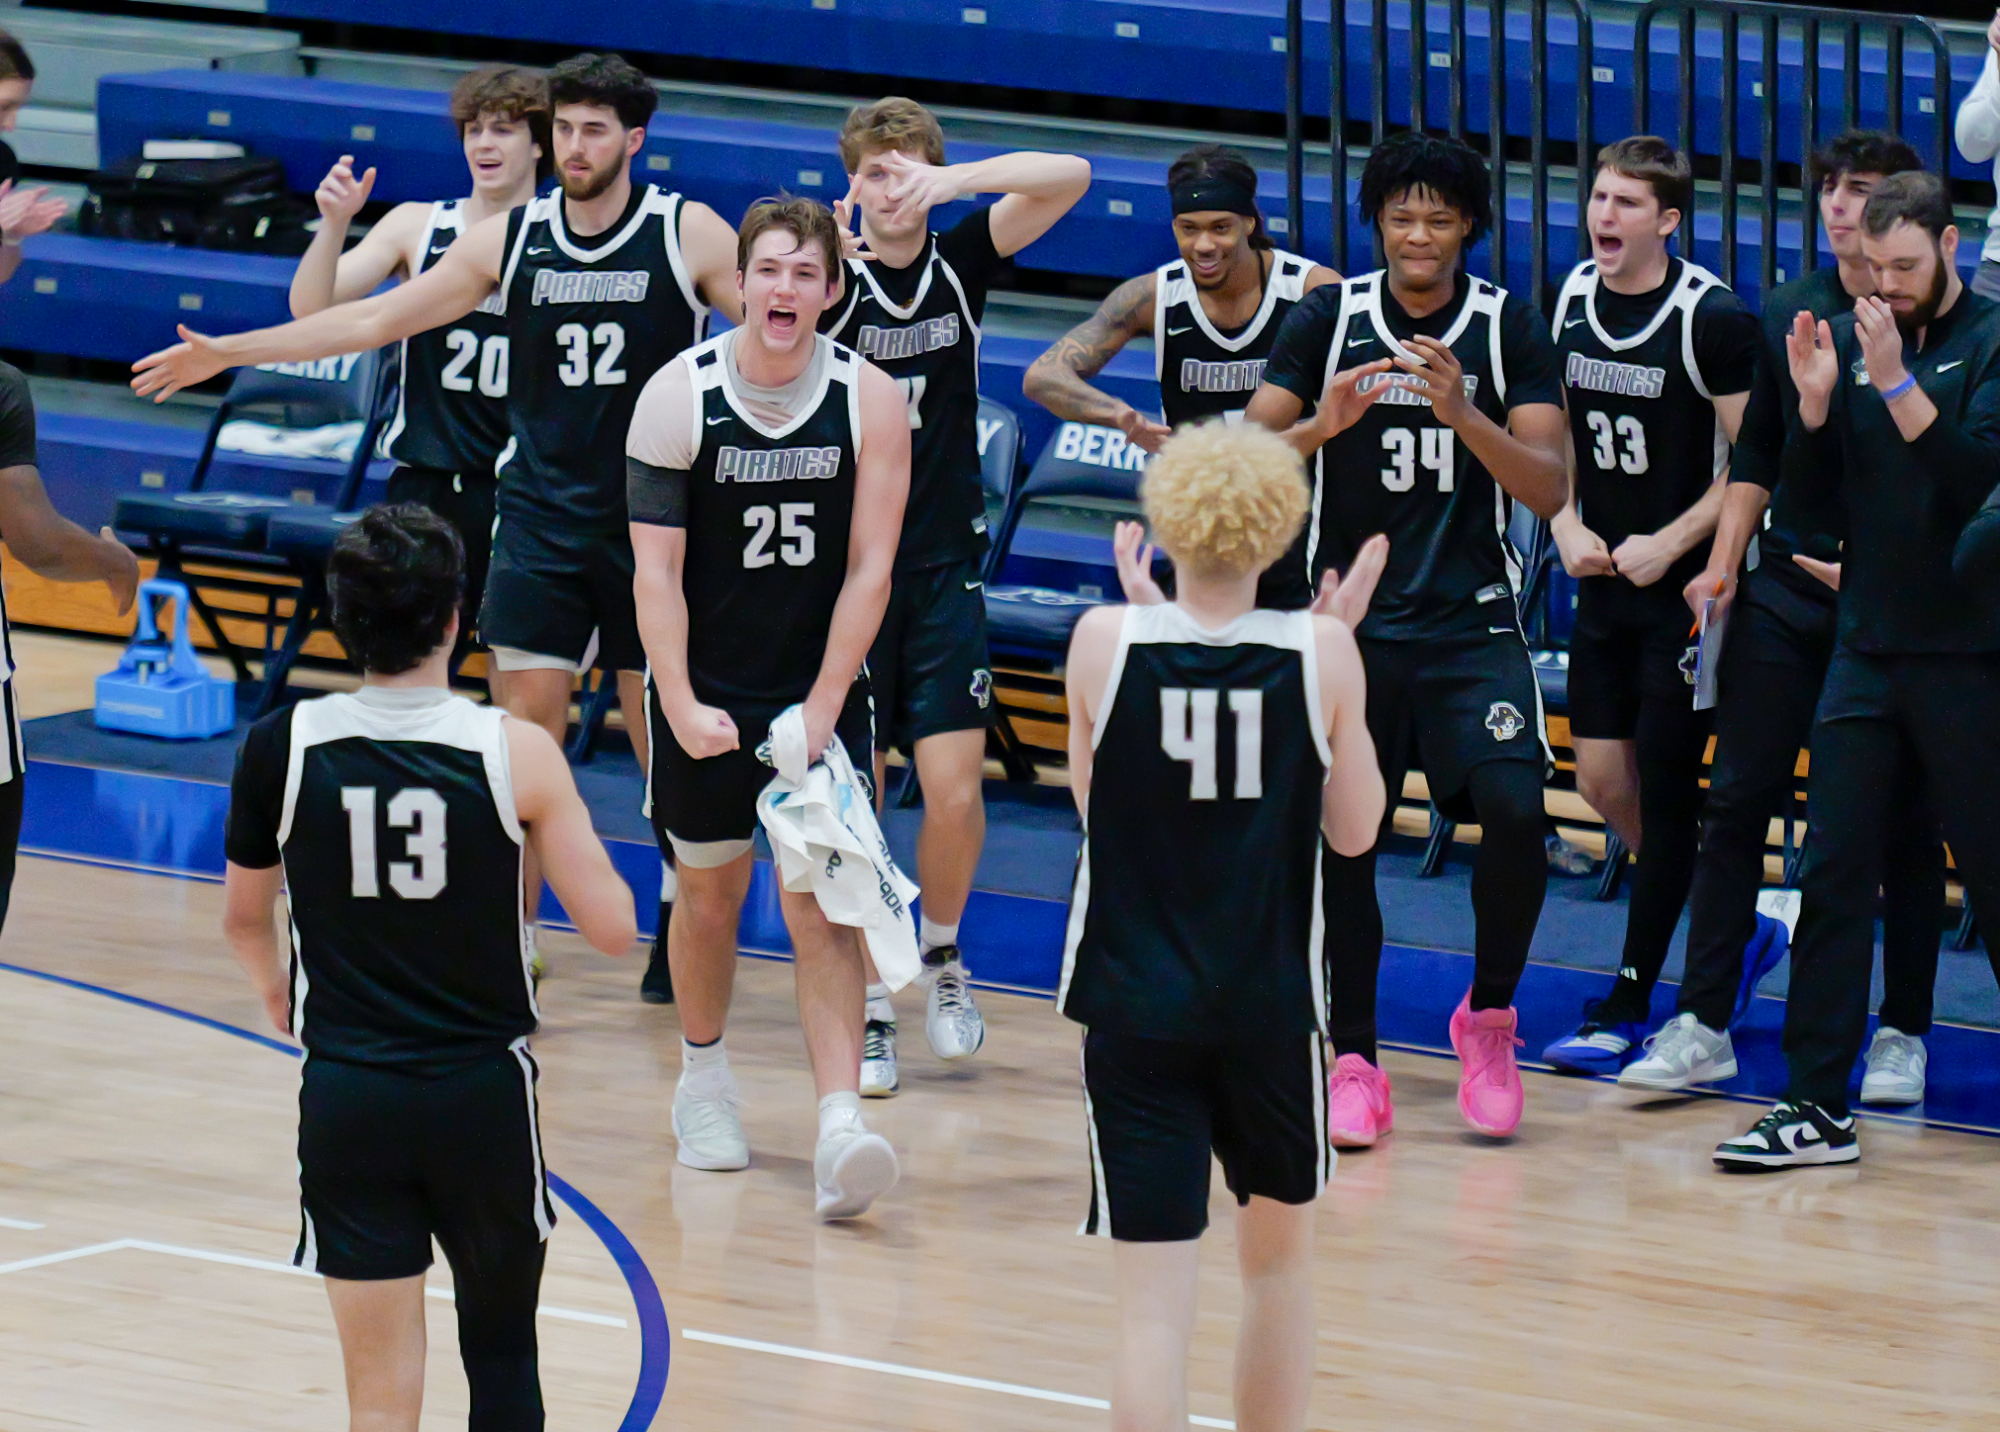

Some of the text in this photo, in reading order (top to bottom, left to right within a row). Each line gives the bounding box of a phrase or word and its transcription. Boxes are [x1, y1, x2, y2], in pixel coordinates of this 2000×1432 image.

[531, 268, 650, 307] PIRATES
[440, 328, 510, 399] 20
[556, 322, 627, 387] 32
[857, 312, 960, 360] PIRATES
[1565, 351, 1666, 398] PIRATES
[715, 446, 842, 483] PIRATES
[1053, 420, 1148, 472] BERR
[1381, 427, 1455, 493] 34
[1586, 409, 1650, 475] 33
[743, 502, 816, 569] 25
[1160, 686, 1263, 800] 41
[341, 786, 448, 900] 13
